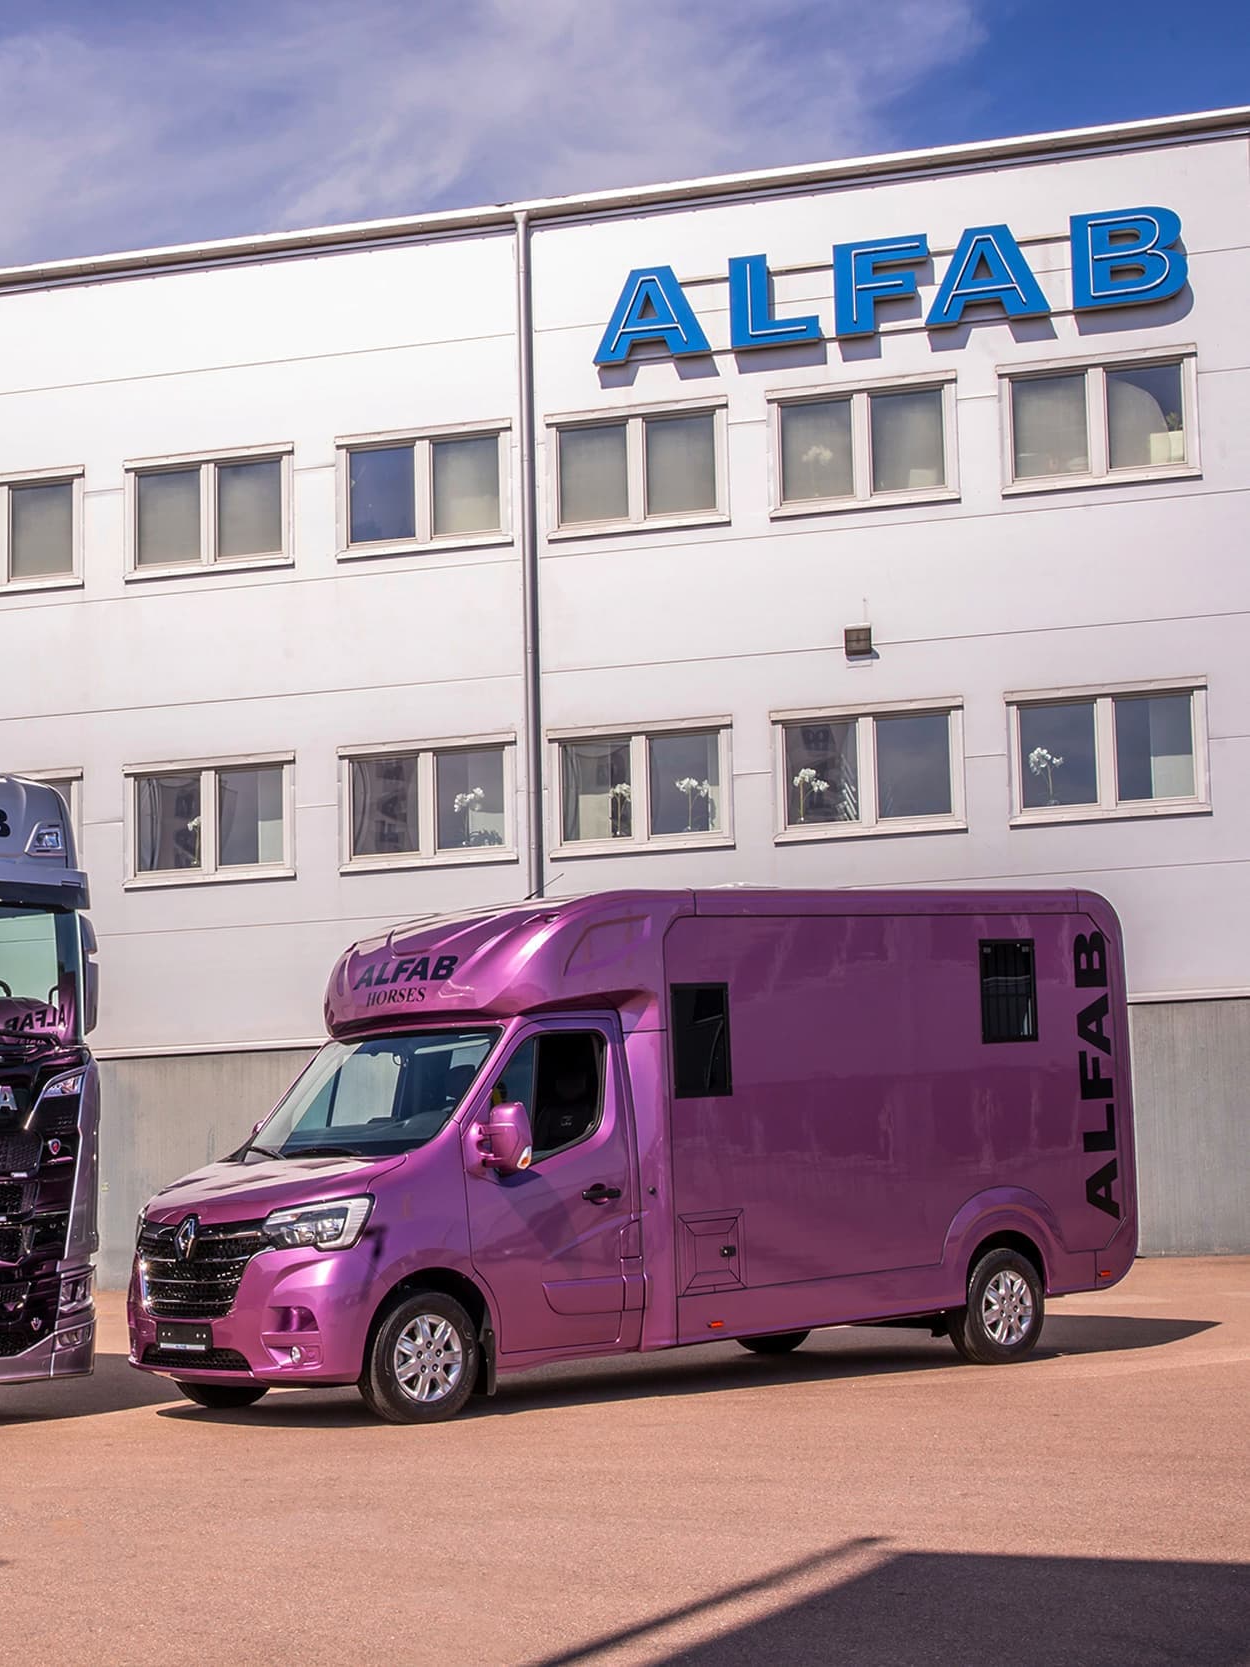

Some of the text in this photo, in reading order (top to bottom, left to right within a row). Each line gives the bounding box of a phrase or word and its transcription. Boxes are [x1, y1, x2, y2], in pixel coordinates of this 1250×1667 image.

[593, 205, 1189, 366] ALFAB
[353, 955, 459, 991] ALFAB
[366, 986, 427, 1008] HORSES
[1073, 930, 1121, 1221] ALFAB
